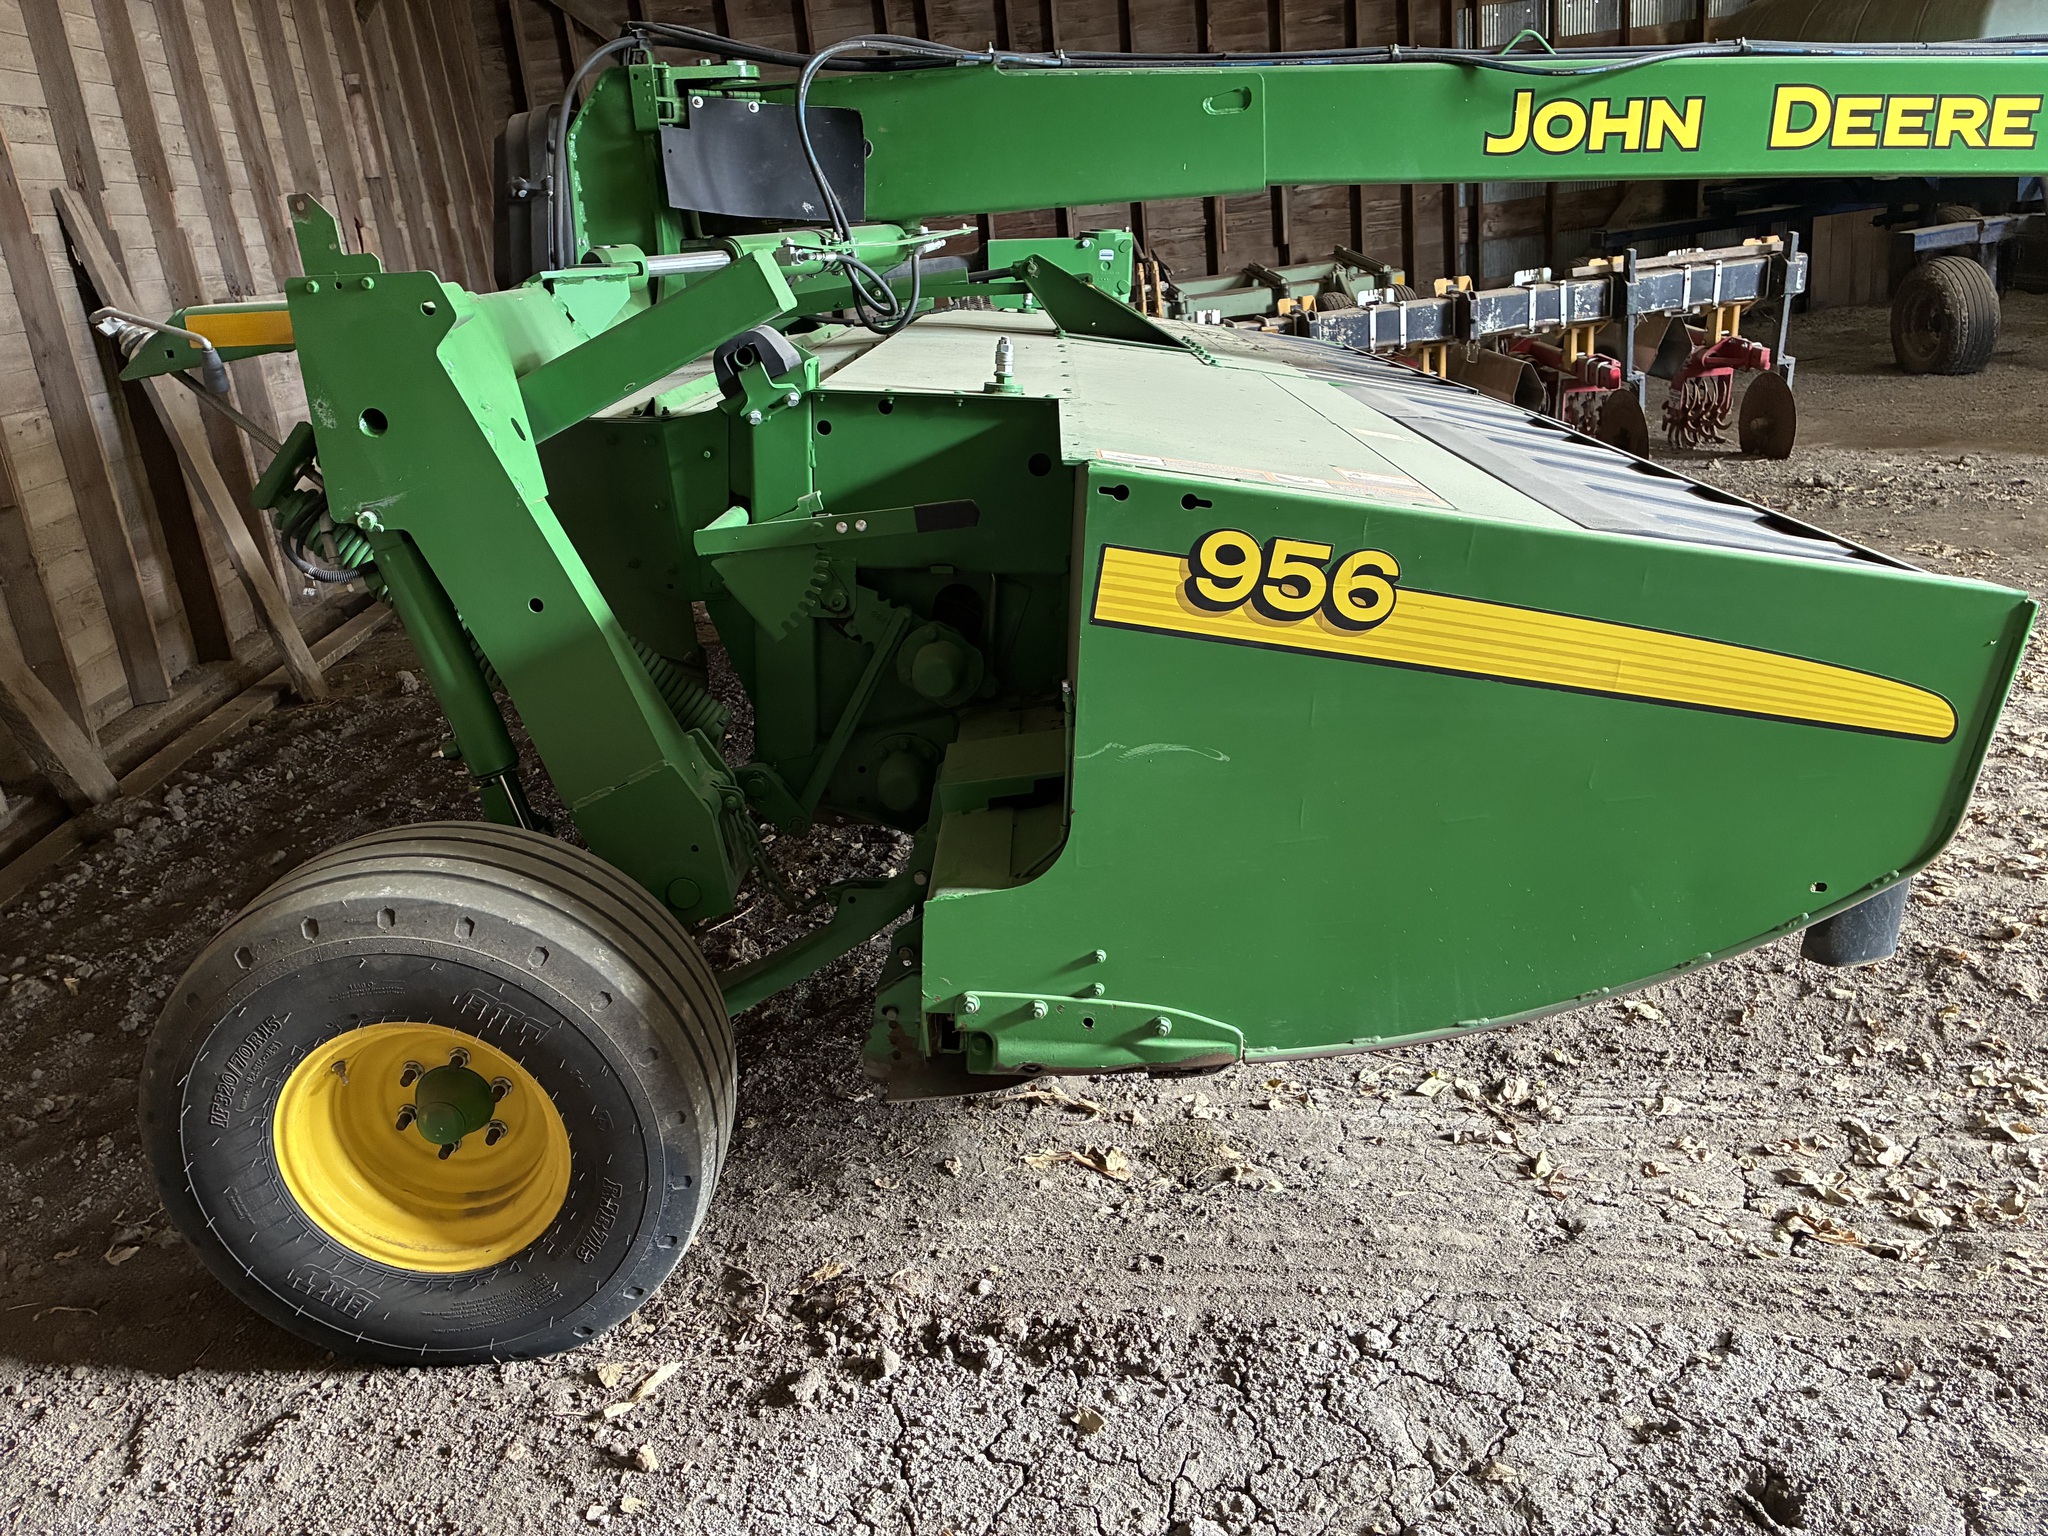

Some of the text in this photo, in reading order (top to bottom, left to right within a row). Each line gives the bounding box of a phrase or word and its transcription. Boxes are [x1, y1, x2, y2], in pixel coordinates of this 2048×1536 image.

[1484, 83, 2045, 156] JOHN DEERE
[1184, 527, 1402, 632] 956
[210, 1013, 283, 1129] IF320/70R15
[285, 1263, 380, 1320] BKT
